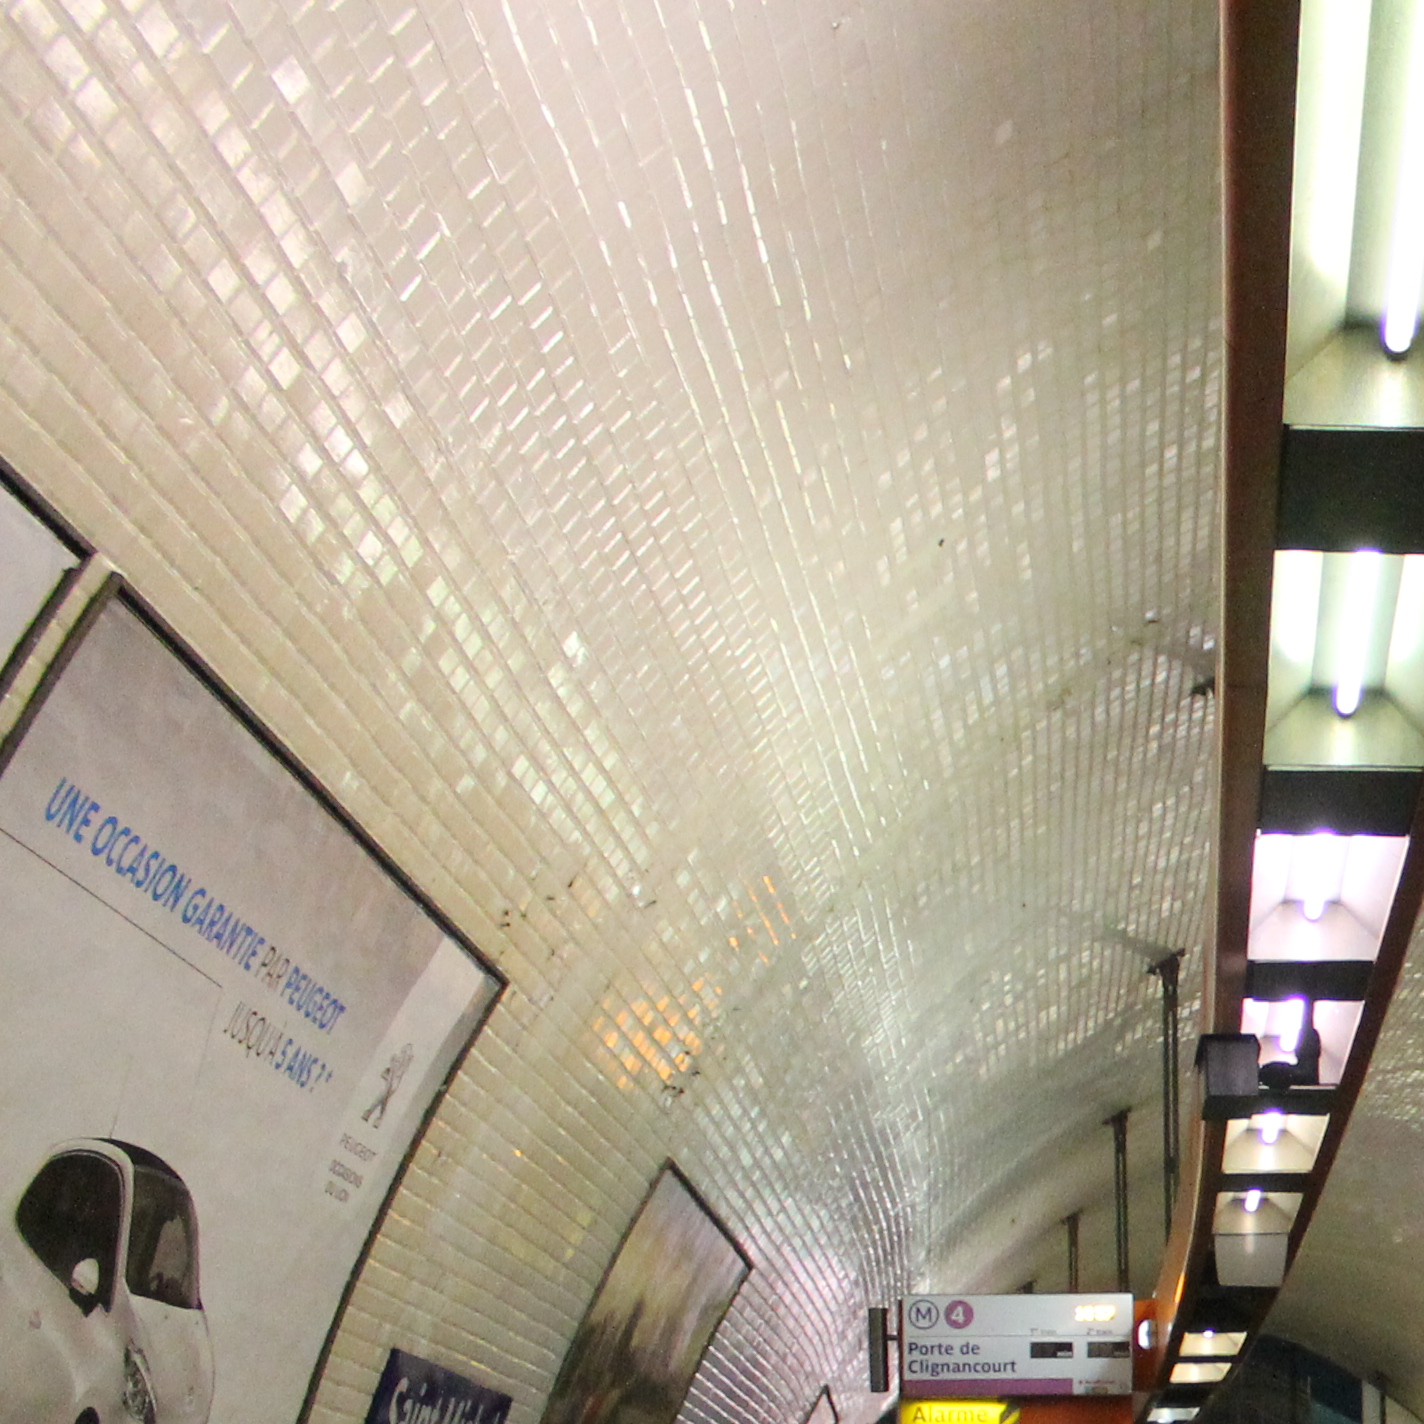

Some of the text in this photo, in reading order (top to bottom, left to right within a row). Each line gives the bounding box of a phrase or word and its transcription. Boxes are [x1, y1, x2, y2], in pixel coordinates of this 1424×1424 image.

[45, 777, 346, 1035] UNE OCCASION GARANTIE PAR PEUGEOT
[284, 1045, 319, 1088] ANS
[950, 1304, 966, 1324] 4
[907, 1341, 981, 1356] Porte de
[907, 1359, 1018, 1377] Clignancourt
[911, 1406, 989, 1424] Alarme
